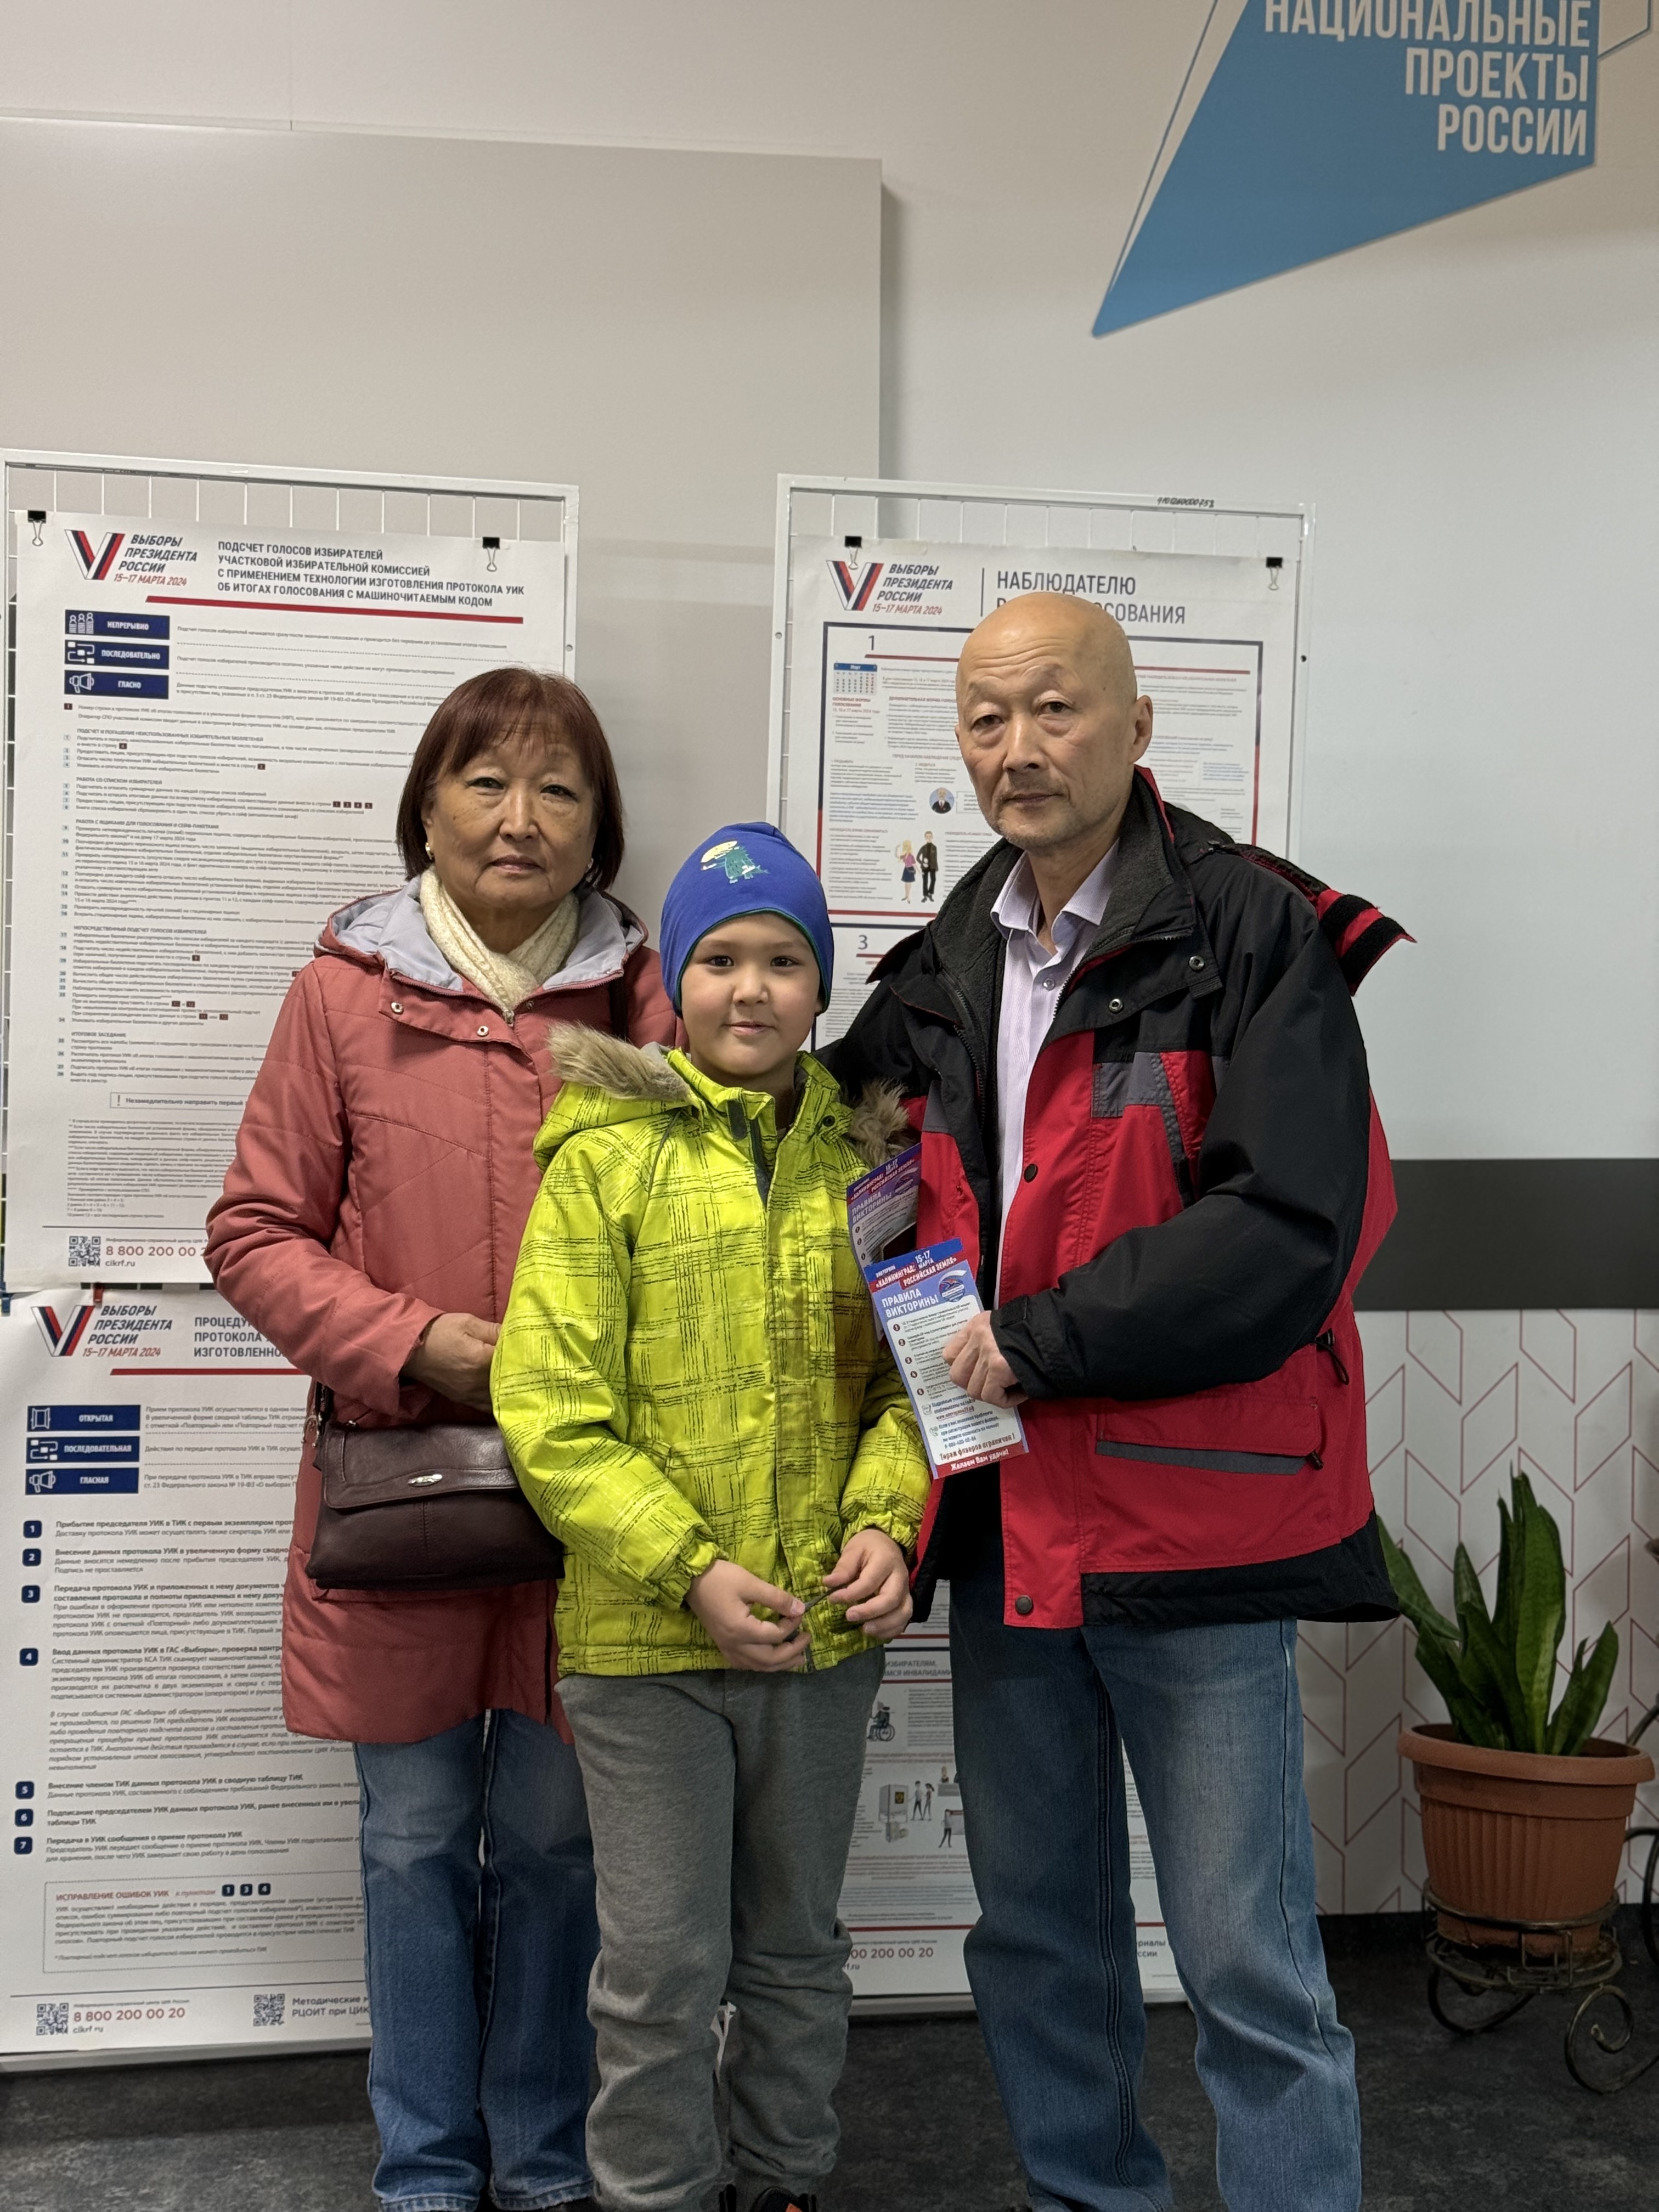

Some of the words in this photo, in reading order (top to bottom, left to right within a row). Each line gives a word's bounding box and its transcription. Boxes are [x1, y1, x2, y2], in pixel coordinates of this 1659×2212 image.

[1265, 0, 1590, 48] НАЦИОНАЛЬНЫЕ
[1405, 48, 1589, 102] ПРОЕКТЫ
[1437, 104, 1587, 155] РОССИИ
[131, 534, 183, 548] ВЫБОРЫ
[125, 548, 198, 562] ПРЕЗИДЕНТА
[218, 541, 264, 554] ПОДСЧЕТ
[267, 544, 312, 556] ГОЛОСОВ
[314, 546, 383, 560] ИЗБИРАТЕЛЕЙ
[119, 561, 166, 573] РОССИИ
[218, 555, 284, 568] УЧАСТКОВОЙ
[285, 558, 369, 573] ИЗБИРАТЕЛЬНОЙ
[371, 563, 430, 576] КОМИССИЕЙ
[888, 563, 939, 575] ВЫБОРЫ
[137, 575, 165, 585] МАРТА
[167, 576, 187, 586] 2024
[218, 568, 225, 578] С
[227, 569, 301, 582] ПРИМЕНЕНИЕМ
[303, 573, 367, 586] ТЕХНОЛОГИИ
[369, 577, 443, 590] ИЗГОТОВЛЕНИЯ
[446, 582, 503, 594] ПРОТОКОЛА
[505, 585, 524, 595] УИК
[882, 577, 953, 590] ПРЕЗИДЕНТА
[997, 571, 1136, 595] НАБЛЮДАТЕЛЮ
[217, 582, 231, 591] ОБ
[233, 583, 272, 594] ИТОГАХ
[273, 585, 345, 598] ГОЛОСОВАНИЯ
[346, 589, 354, 598] С
[356, 589, 456, 605] МАШИНОЧИТАЕМЫМ
[458, 595, 493, 607] КОДОМ
[877, 591, 922, 602] РОССИИ
[894, 605, 922, 614] МАРТА
[923, 606, 943, 615] 2024
[1094, 602, 1186, 624] СОВАНИЯ
[107, 621, 149, 630] НЕПРЕРЫВНО
[868, 635, 874, 651] 1
[101, 650, 160, 660] ПОСЛЕДОВАТЕЛЬНО
[118, 680, 141, 689] ГЛАСНО
[857, 934, 868, 950] 3
[126, 1097, 183, 1106] Незамедлительно
[851, 1192, 882, 1216] ПРАВИЛА
[853, 1192, 892, 1223] ВИКТОРИНЫ
[106, 1246, 114, 1256] 8
[118, 1246, 144, 1256] 800
[148, 1246, 174, 1256] 200
[178, 1247, 196, 1256] 00
[915, 1250, 930, 1261] 15-17
[918, 1259, 934, 1269] МАРТА
[903, 1266, 935, 1286] РОССИЙСКАЯ
[935, 1256, 957, 1271] ЗЕМЛЯ»
[882, 1288, 922, 1308] ПРАВИЛА
[100, 1305, 157, 1317] ВЫБОРЫ
[885, 1294, 939, 1318] ВИКТОРИНЫ
[94, 1319, 172, 1331] ПРЕЗИДЕНТА
[194, 1317, 251, 1329] ПРОЦЕДУ
[88, 1334, 138, 1345] РОССИИ
[194, 1332, 262, 1342] ПРОТОКОЛА
[109, 1347, 138, 1358] МАРТА
[139, 1348, 161, 1358] 2024
[194, 1347, 284, 1358] ИЗГОТОВЛЕННО
[79, 1414, 114, 1423] ОТКРЫТАЯ
[64, 1444, 132, 1453] ПОСЛЕДОВАТЕЛЬНАЯ
[950, 1460, 975, 1471] Желаем
[976, 1455, 988, 1464] Вам
[80, 1476, 109, 1485] ГЛАСНАЯ
[27, 1590, 33, 1598] 3
[25, 1652, 32, 1661] 4
[56, 1892, 115, 1901] ИСПРАВЛЕНИЕ
[116, 1891, 151, 1899] ОШИБОК
[850, 1949, 867, 1959] 00
[871, 1948, 894, 1959] 200
[898, 1948, 915, 1958] 00
[918, 1947, 933, 1957] 20
[292, 1996, 360, 2006] Методические
[74, 2012, 82, 2022] 8
[85, 2011, 112, 2022] 800
[116, 2010, 143, 2020] 200
[146, 2008, 165, 2019] 00
[168, 2007, 185, 2018] 20
[292, 2007, 326, 2017] РЦОИТ
